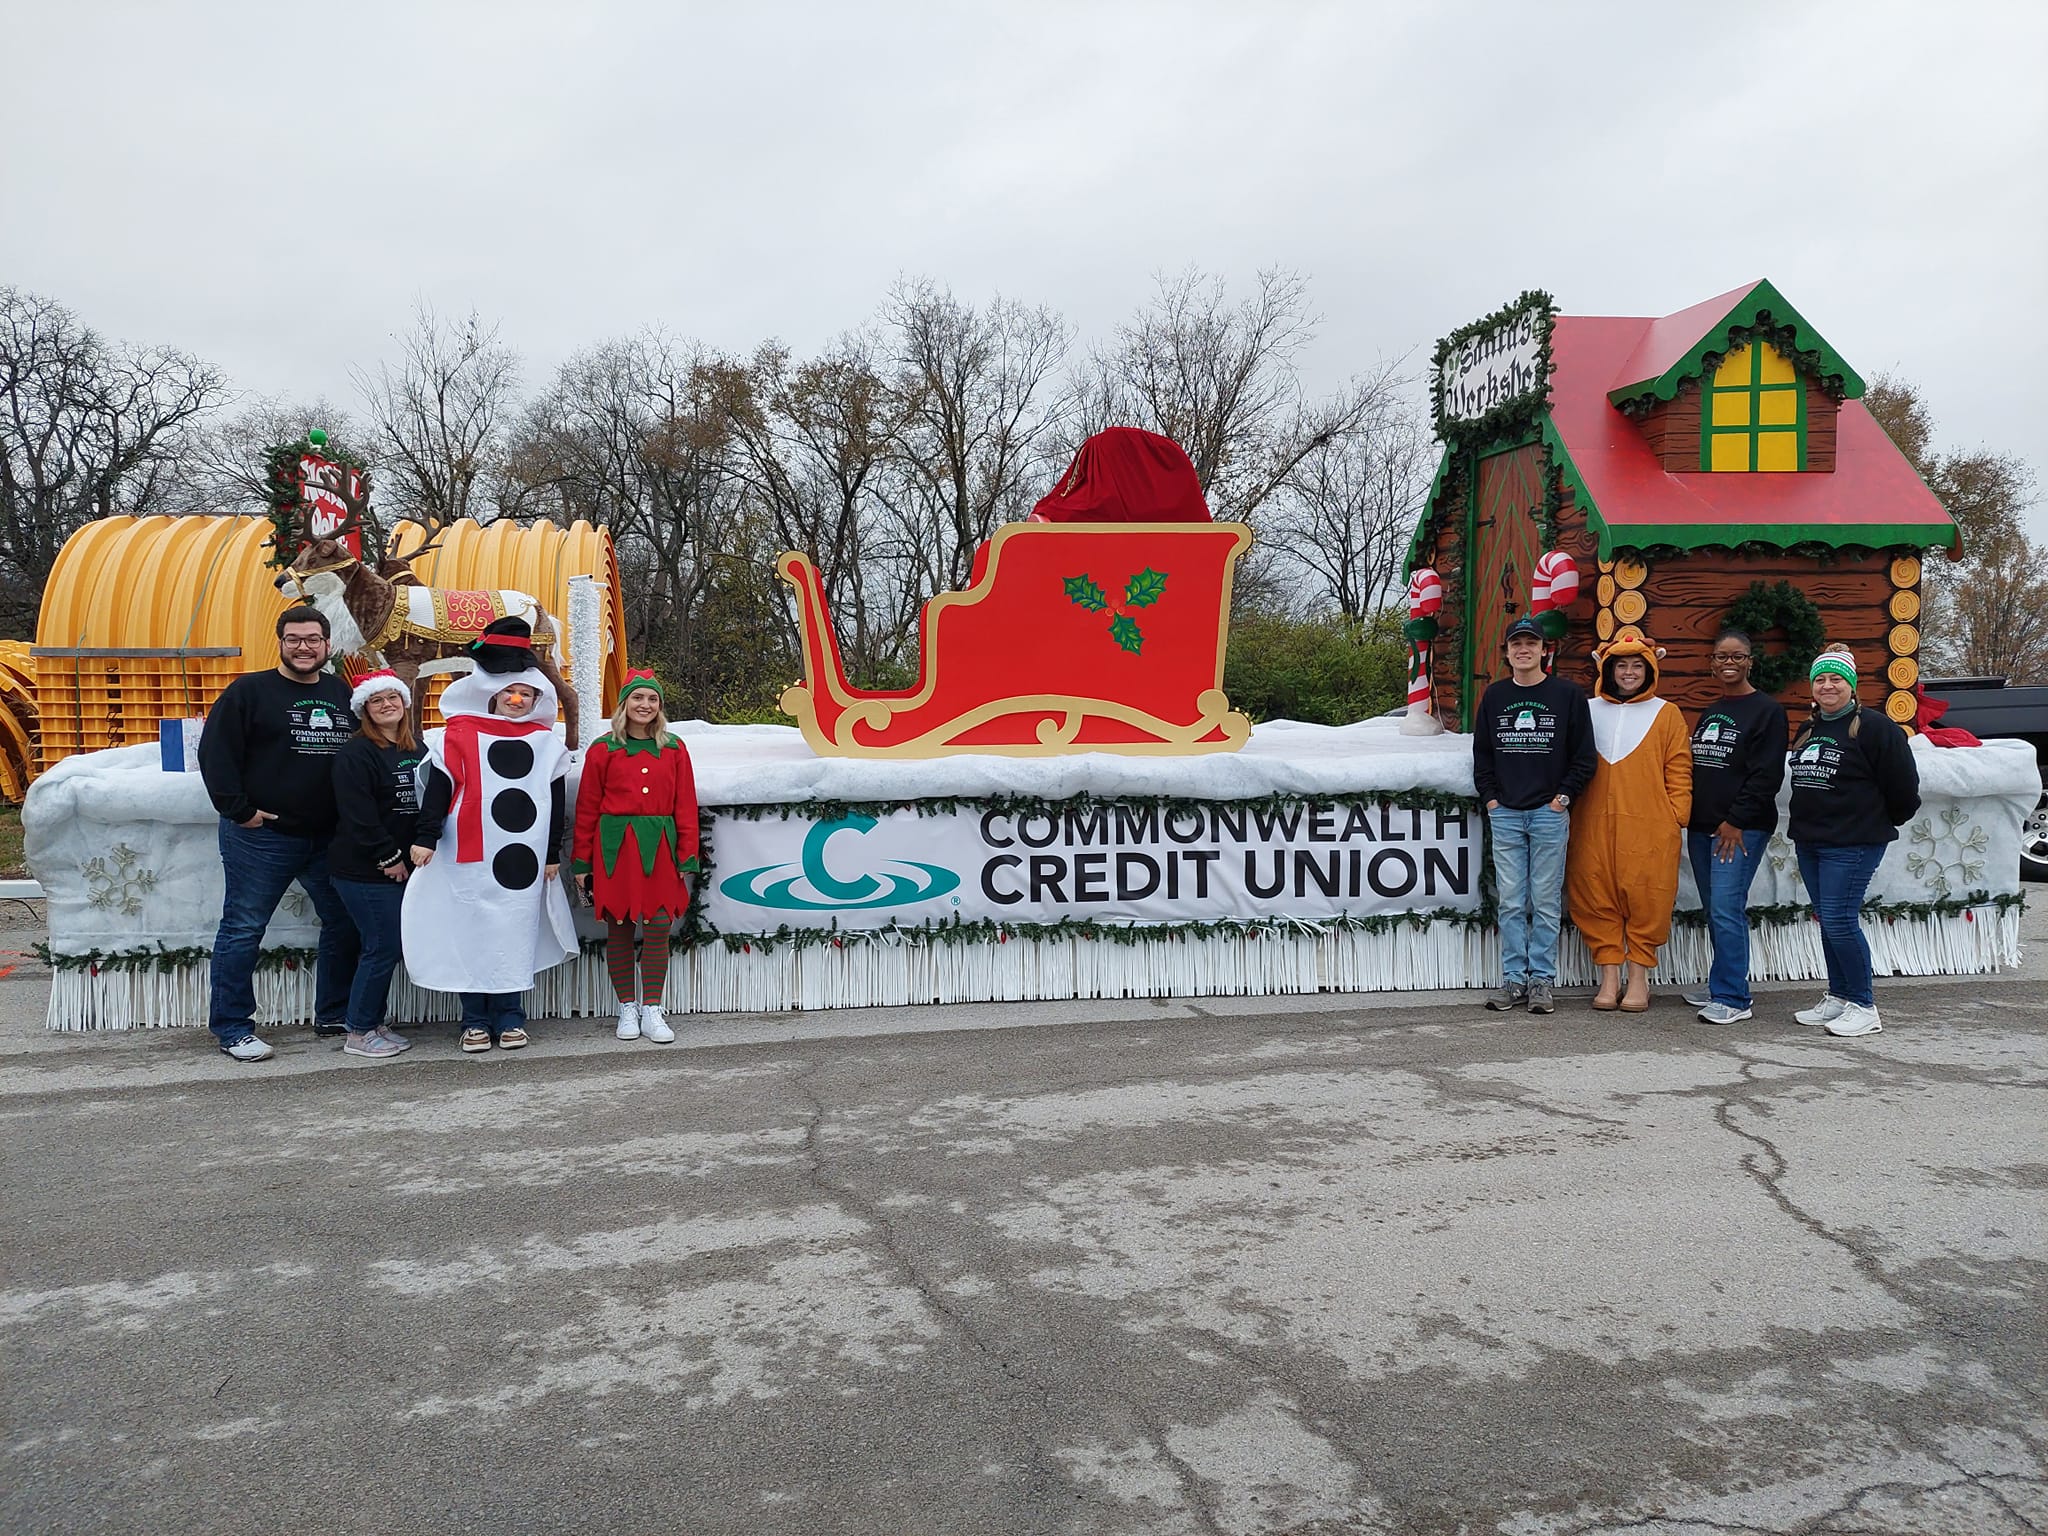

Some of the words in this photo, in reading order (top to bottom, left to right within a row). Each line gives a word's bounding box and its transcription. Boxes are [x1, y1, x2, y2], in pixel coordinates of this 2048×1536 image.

[1445, 354, 1535, 420] Worksho
[802, 810, 881, 900] C
[980, 802, 1468, 848] COMMONWEALTH
[981, 851, 1220, 904] CREDIT
[1245, 847, 1469, 899] UNION
